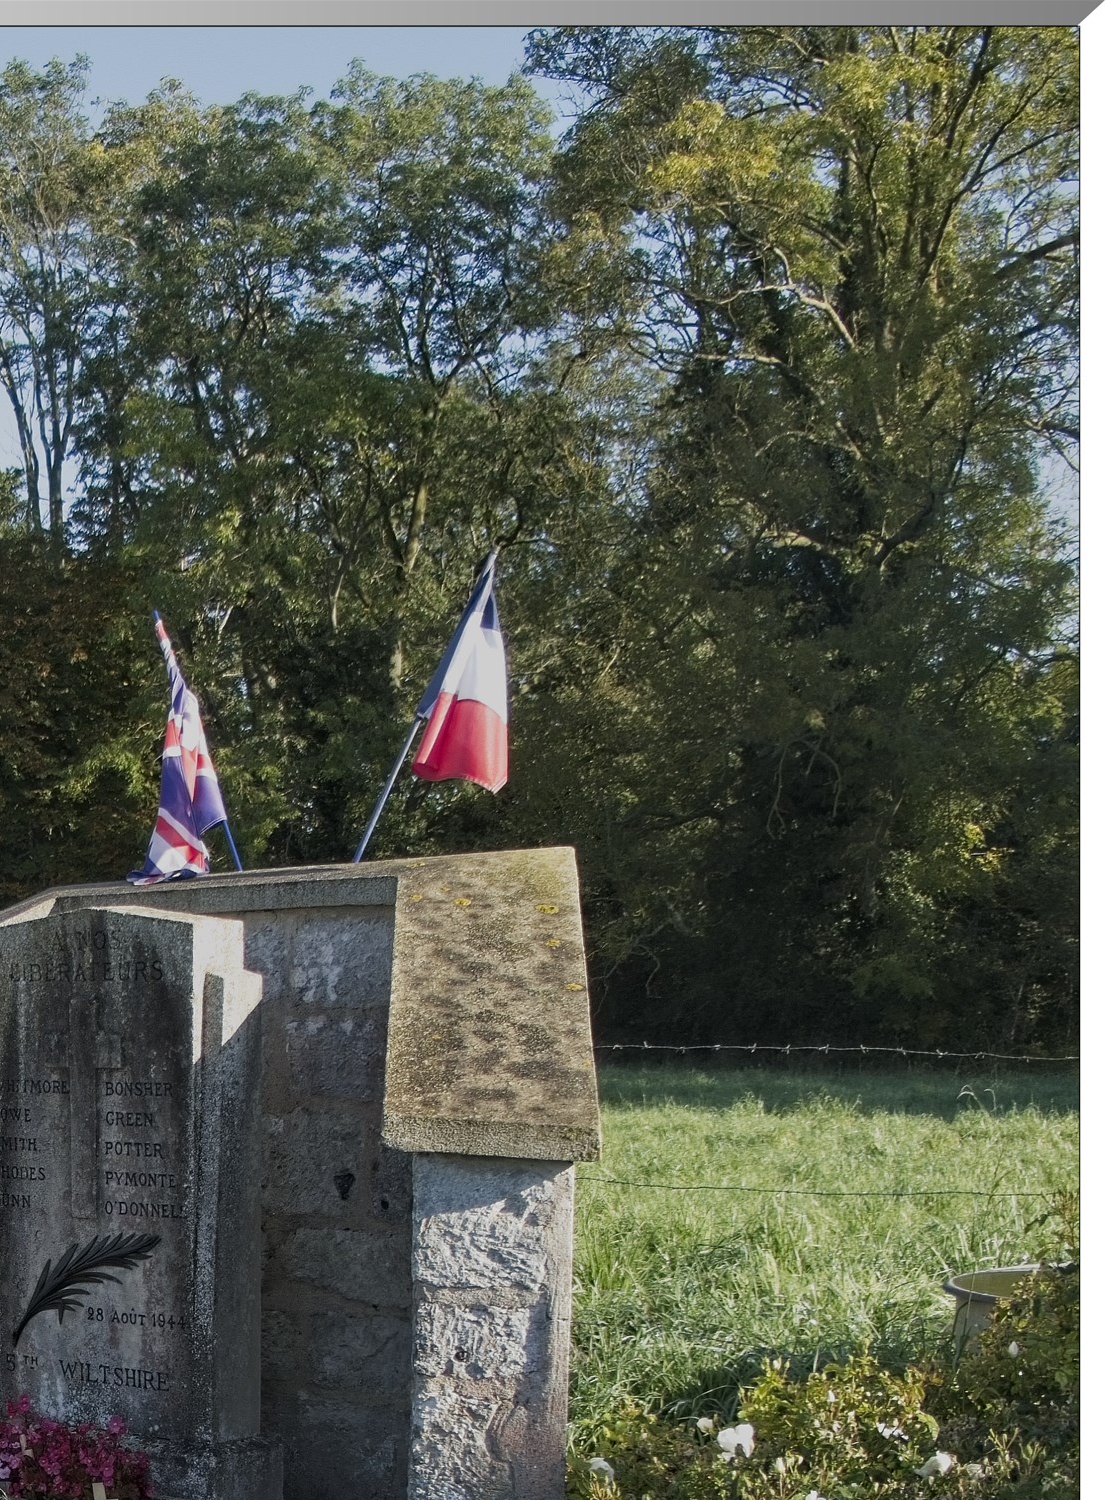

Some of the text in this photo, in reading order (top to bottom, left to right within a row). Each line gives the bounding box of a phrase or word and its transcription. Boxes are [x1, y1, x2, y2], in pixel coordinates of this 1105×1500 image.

[76, 930, 122, 950] NOS
[105, 1081, 173, 1097] BONSHER
[105, 1111, 153, 1127] GREEN
[105, 1141, 163, 1158] POTTER
[105, 1171, 176, 1188] PYMONTE
[104, 1200, 187, 1219] O'DONNELL
[87, 1306, 104, 1322] 28
[152, 1313, 187, 1329] 1944
[58, 1359, 170, 1392] WILTSHIRE
